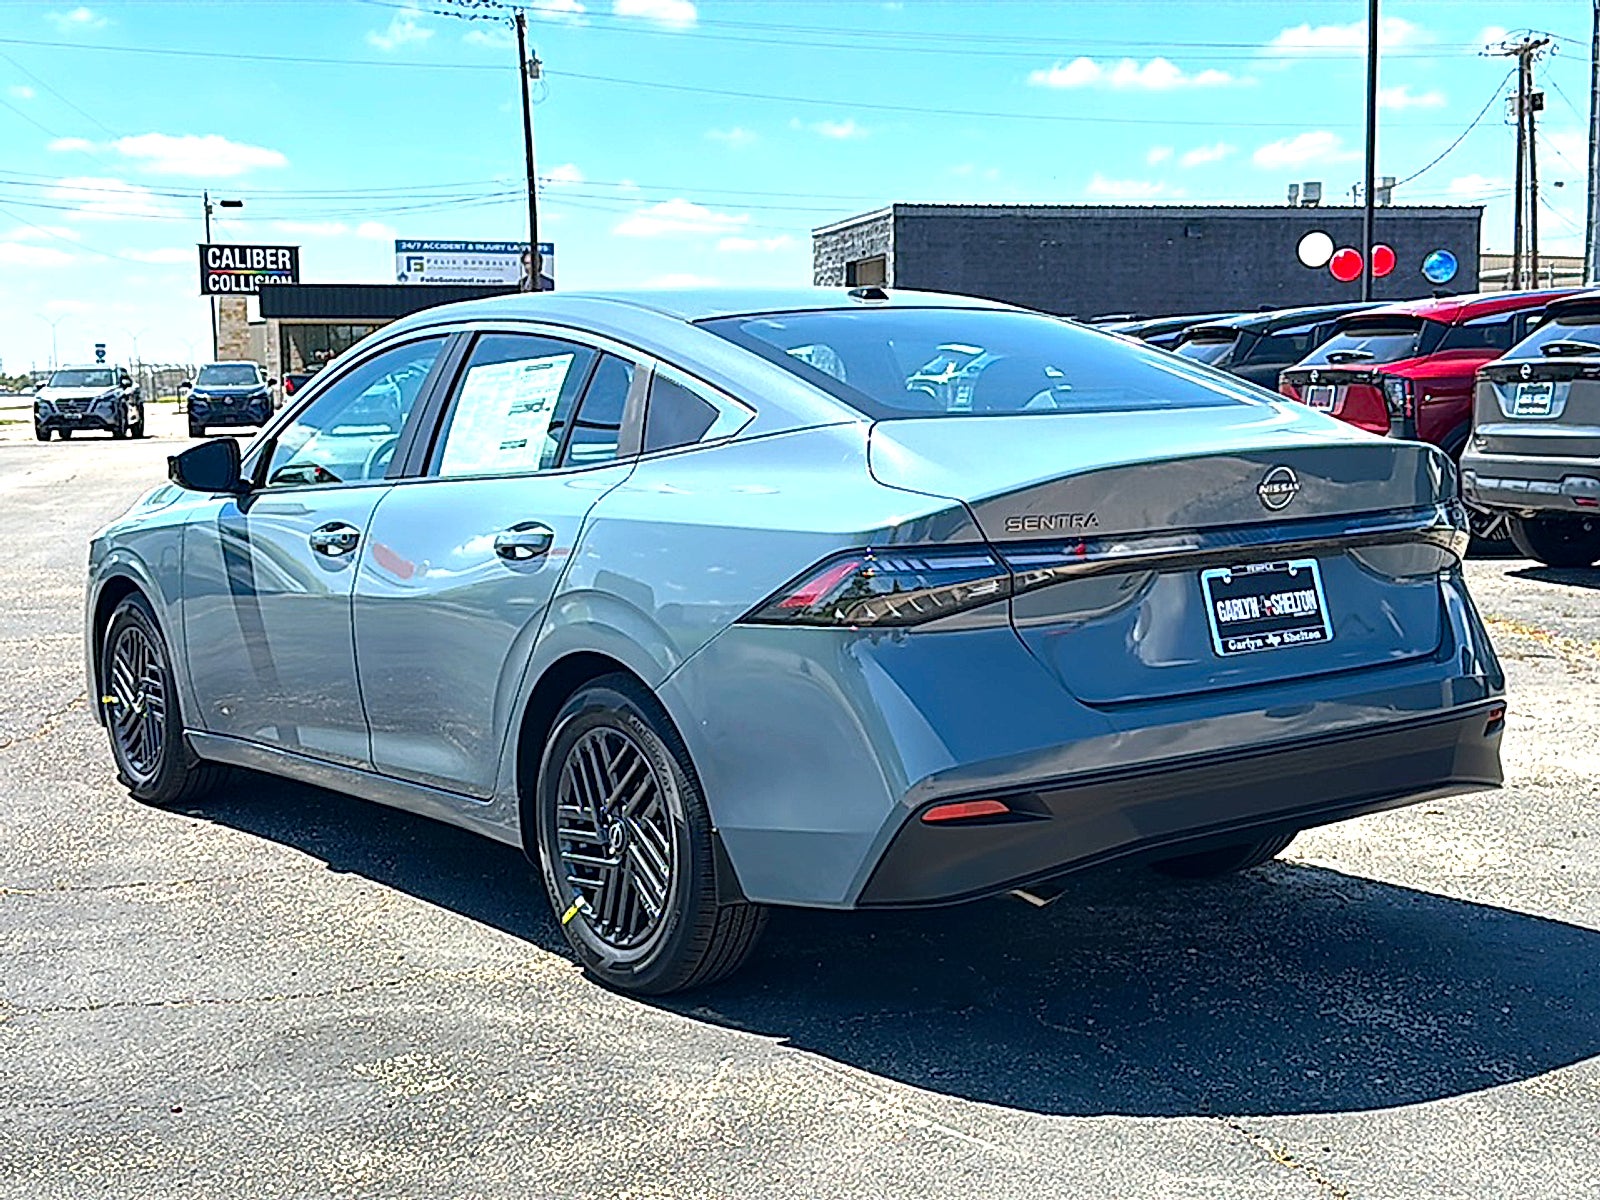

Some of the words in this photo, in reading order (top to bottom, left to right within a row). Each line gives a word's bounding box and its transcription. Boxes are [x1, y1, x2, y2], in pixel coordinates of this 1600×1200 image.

[401, 241, 421, 250] 24/7
[422, 242, 466, 250] ACCIDENT
[475, 243, 506, 251] INJURY
[207, 247, 291, 269] CALIBER
[1259, 482, 1300, 494] NISSAN
[1005, 512, 1100, 532] SENTRA
[1216, 596, 1260, 622] GARLYN
[1270, 589, 1318, 615] SHELTON
